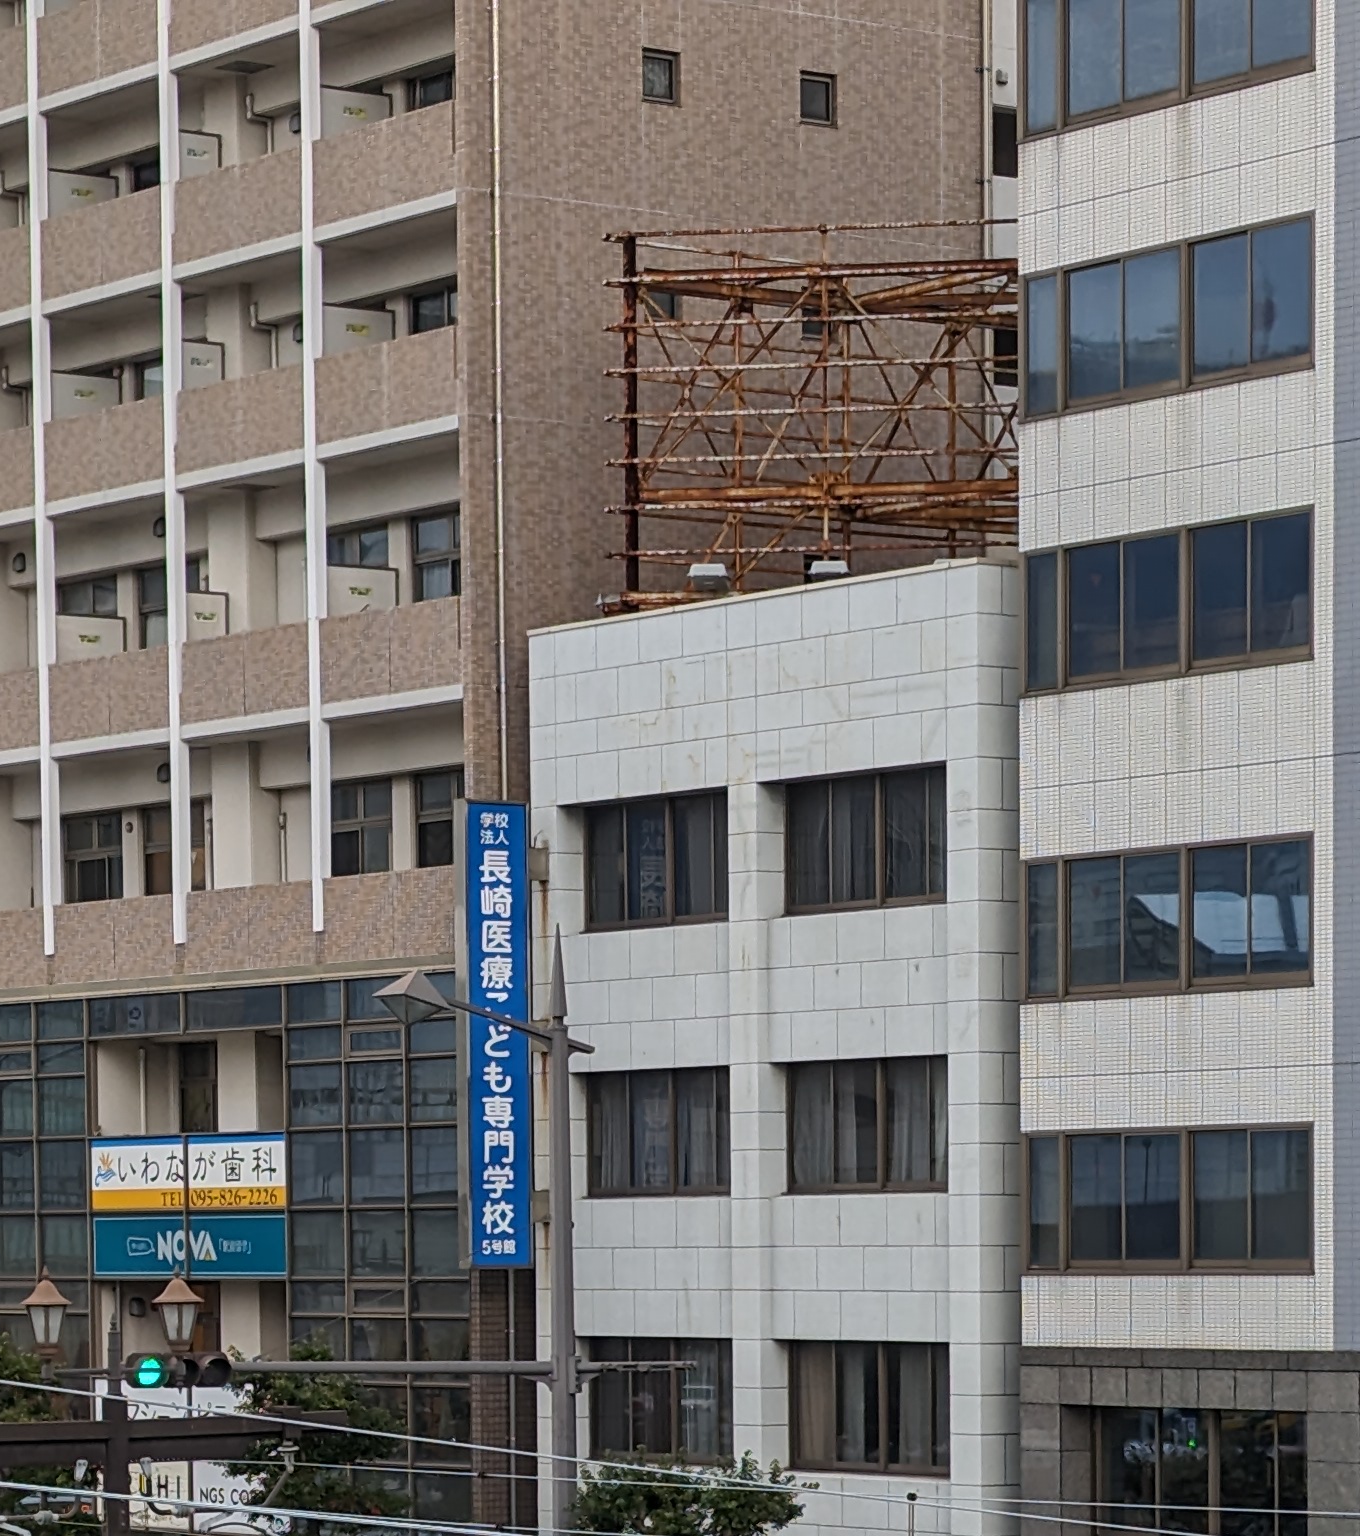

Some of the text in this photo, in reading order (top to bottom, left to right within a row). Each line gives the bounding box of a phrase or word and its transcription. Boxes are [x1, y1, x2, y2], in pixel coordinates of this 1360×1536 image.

[480, 812, 510, 828] 学校
[480, 828, 510, 845] 法人
[117, 1147, 277, 1184] いわなが歯科
[161, 1187, 278, 1207] TEL 095-826-2226
[157, 1229, 218, 1265] NOVA
